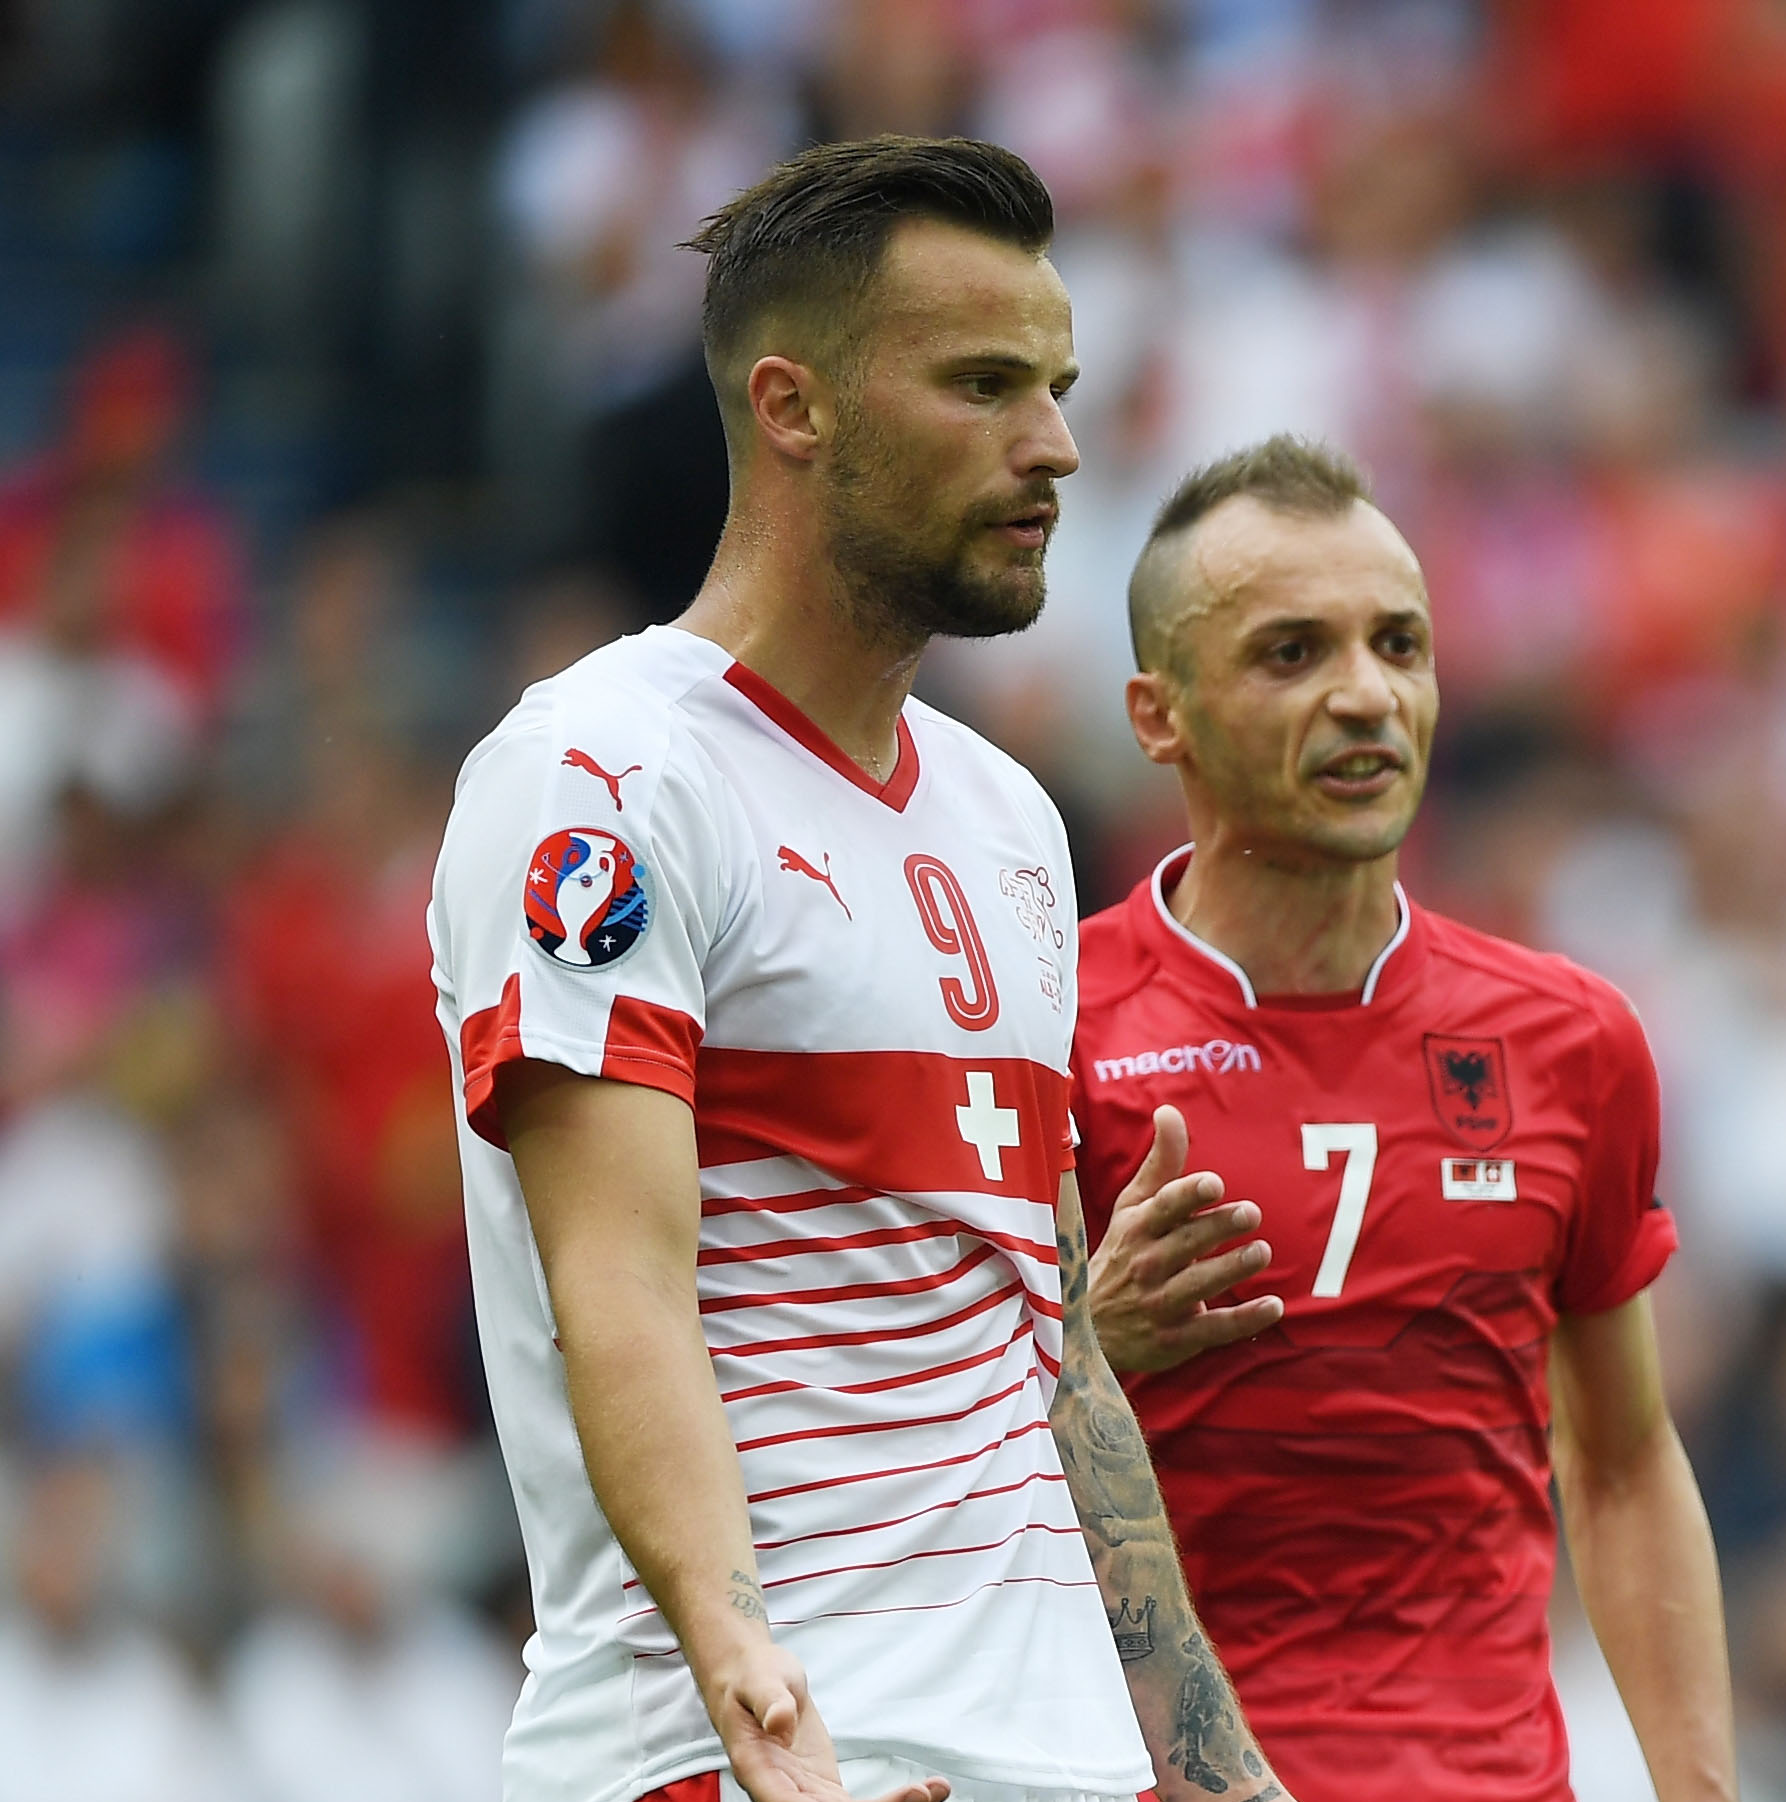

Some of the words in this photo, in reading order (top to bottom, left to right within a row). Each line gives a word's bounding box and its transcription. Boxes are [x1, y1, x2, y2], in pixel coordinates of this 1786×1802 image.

[903, 853, 1000, 1031] 9
[1094, 1040, 1261, 1082] macron
[1301, 1123, 1378, 1297] 7
